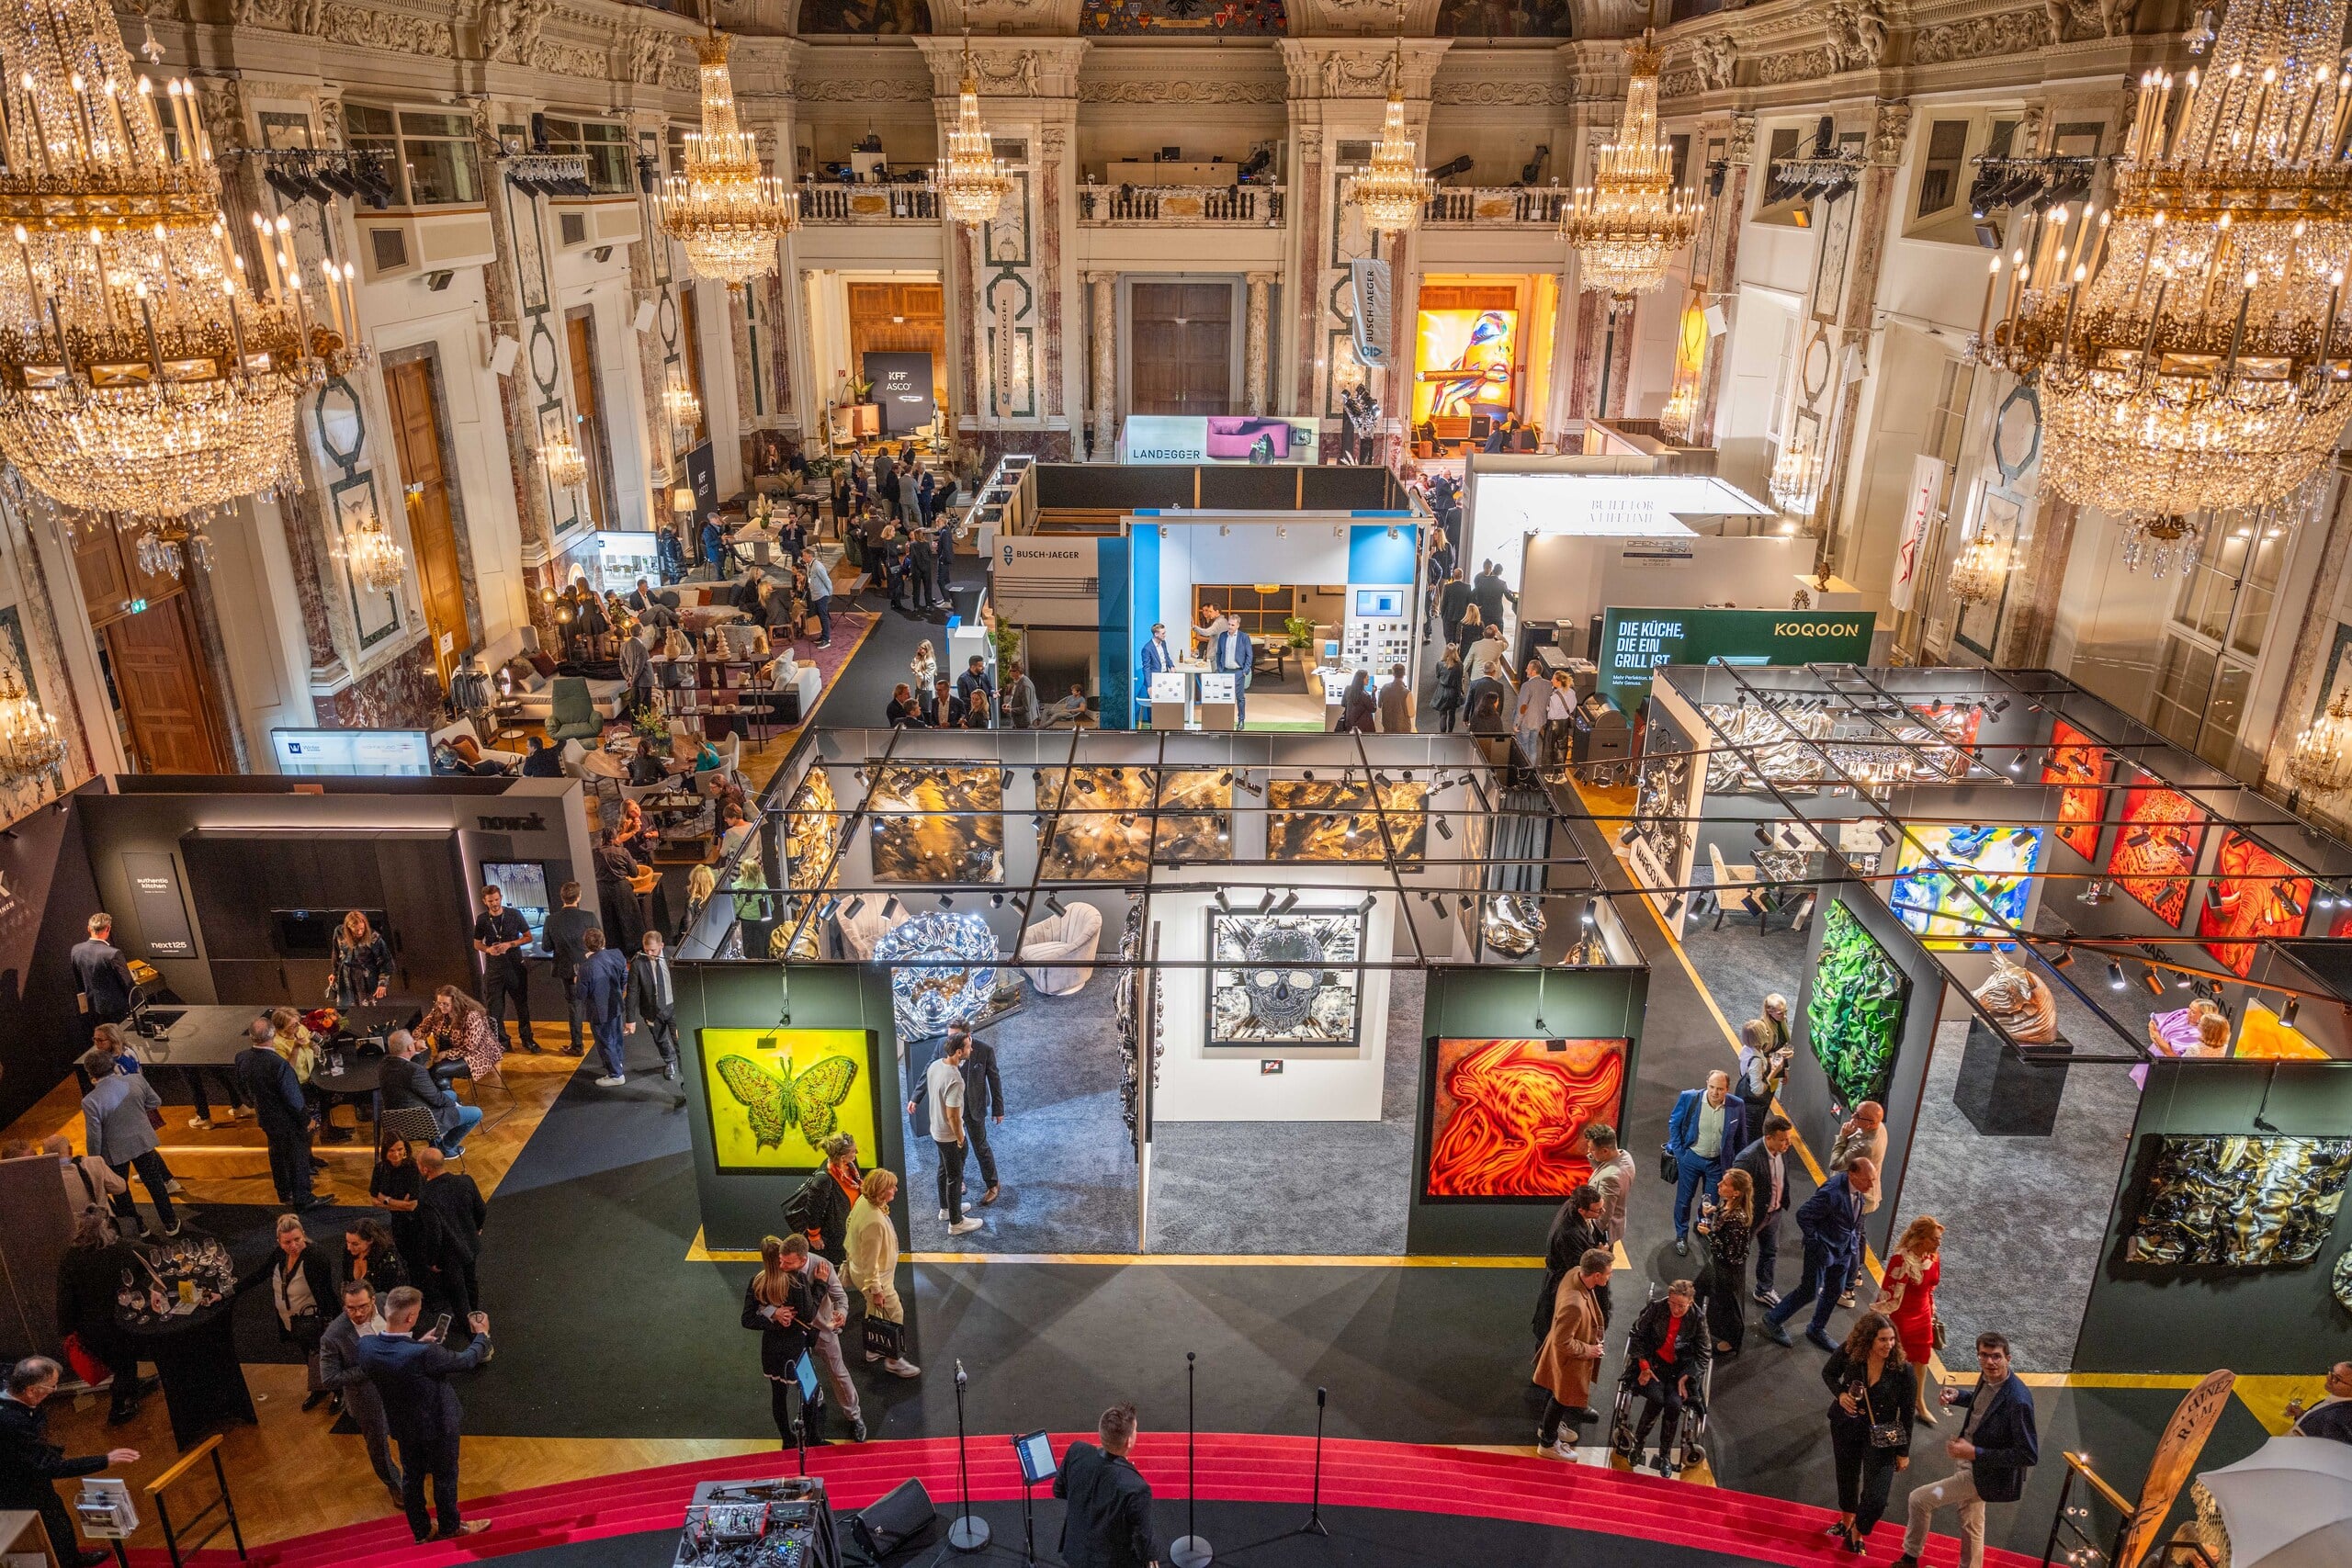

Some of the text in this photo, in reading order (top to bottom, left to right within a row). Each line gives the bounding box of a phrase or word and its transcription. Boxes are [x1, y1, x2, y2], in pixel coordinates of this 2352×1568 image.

[1366, 270, 1374, 343] BUSCH-JAEGER
[888, 371, 908, 380] KFF
[1133, 449, 1200, 459] LANDEGGER
[1016, 550, 1080, 558] BUSCH-JAEGER
[1618, 620, 1684, 639] DIE KÜCHE,
[1774, 623, 1860, 637] KOQOON
[1616, 637, 1660, 653] DIE EIN
[1614, 653, 1670, 668] GRILL IST
[151, 942, 187, 950] next125
[867, 1331, 892, 1348] DIVA
